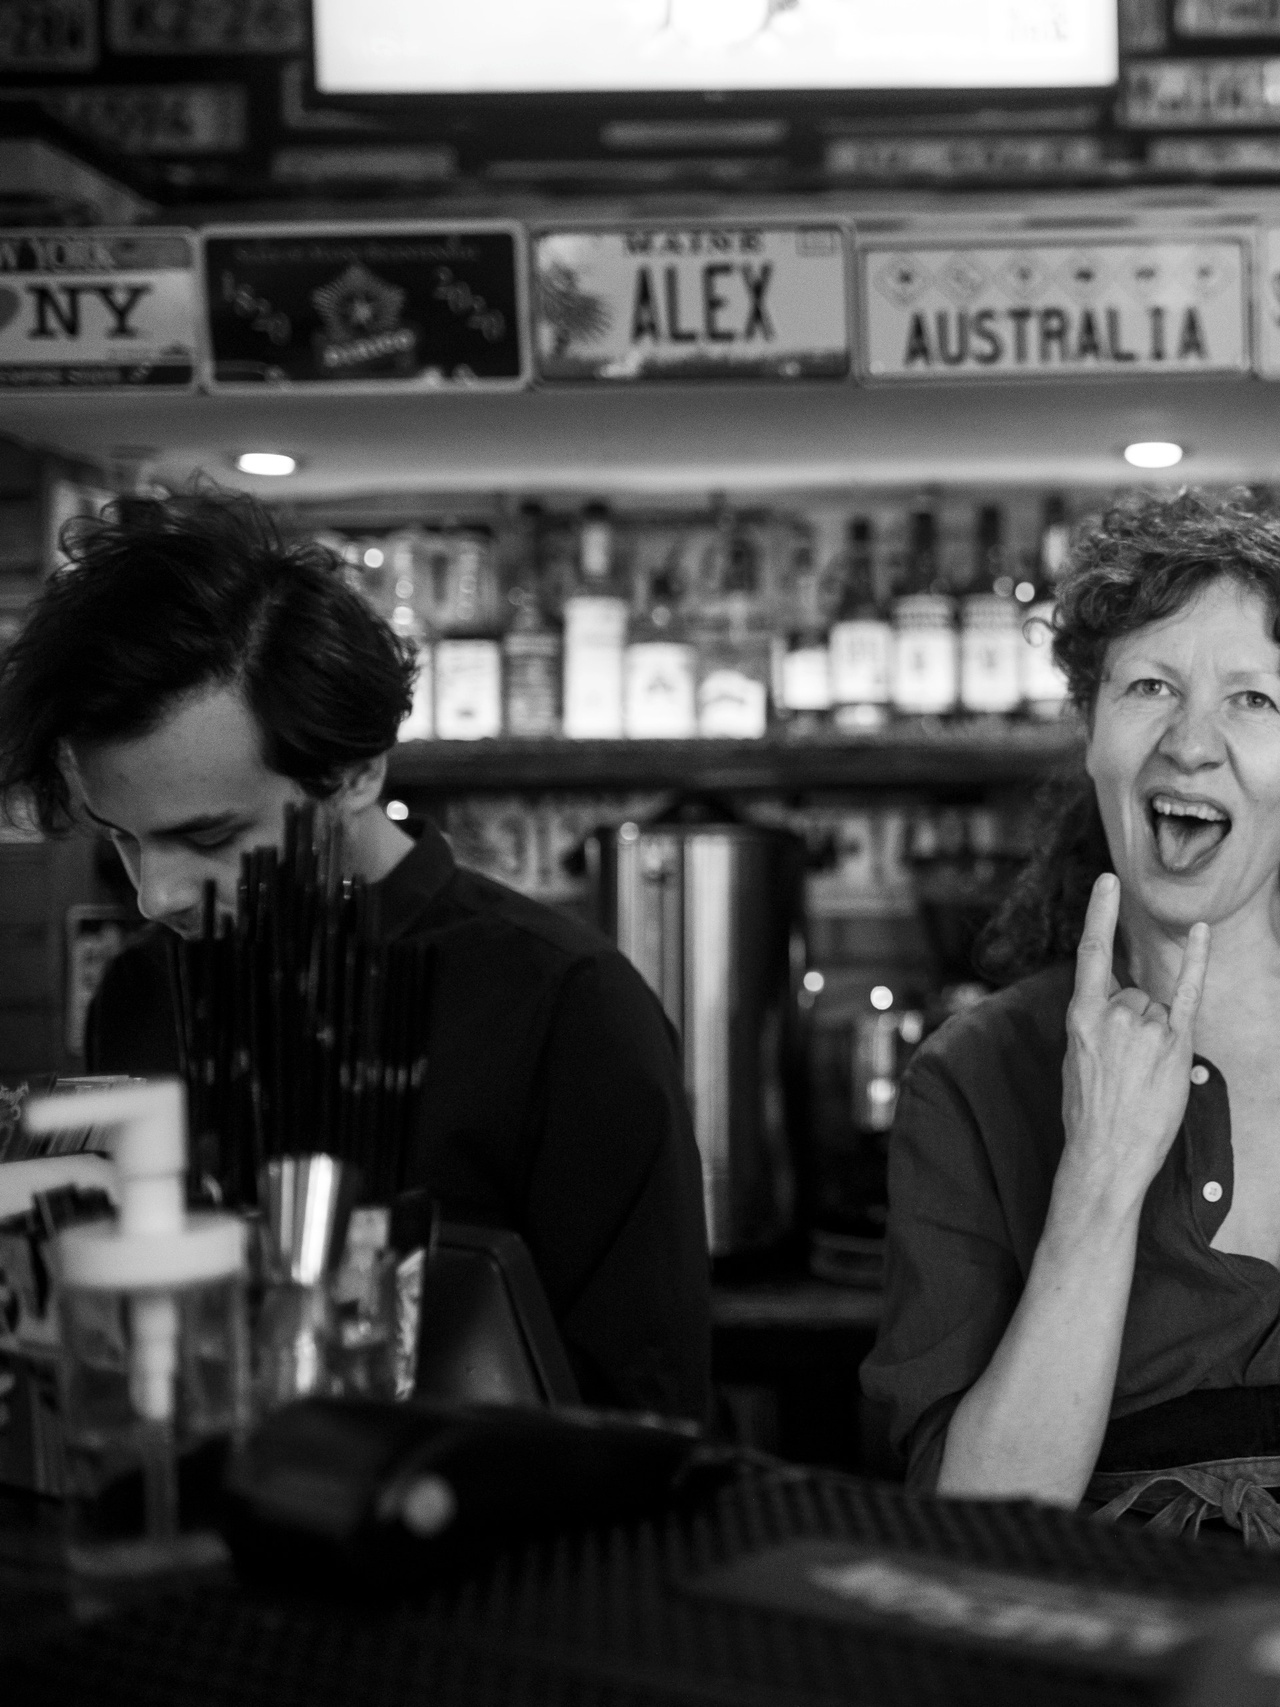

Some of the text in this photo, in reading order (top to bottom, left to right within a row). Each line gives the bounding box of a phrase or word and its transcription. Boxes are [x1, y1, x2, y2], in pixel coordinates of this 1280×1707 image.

[26, 282, 153, 341] NY
[630, 264, 776, 343] ALEX
[903, 306, 1210, 367] AUSTRALIA
